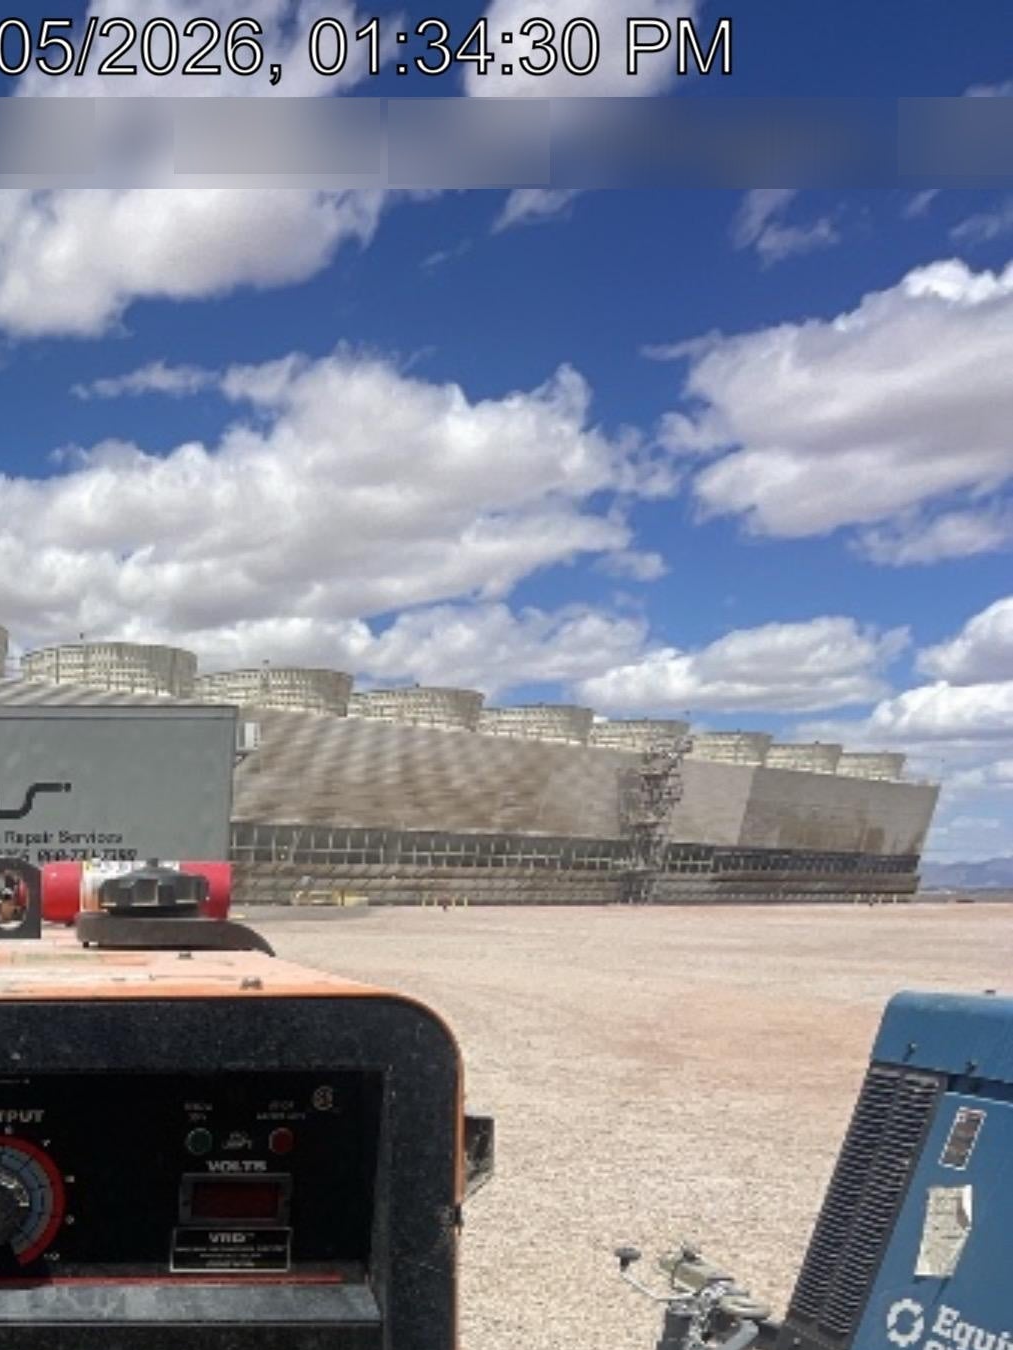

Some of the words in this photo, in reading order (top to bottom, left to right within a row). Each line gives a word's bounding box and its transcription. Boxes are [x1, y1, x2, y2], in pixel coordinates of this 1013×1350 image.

[5, 831, 54, 847] Repair
[58, 831, 123, 845] Services
[206, 1161, 267, 1173] VOLTS
